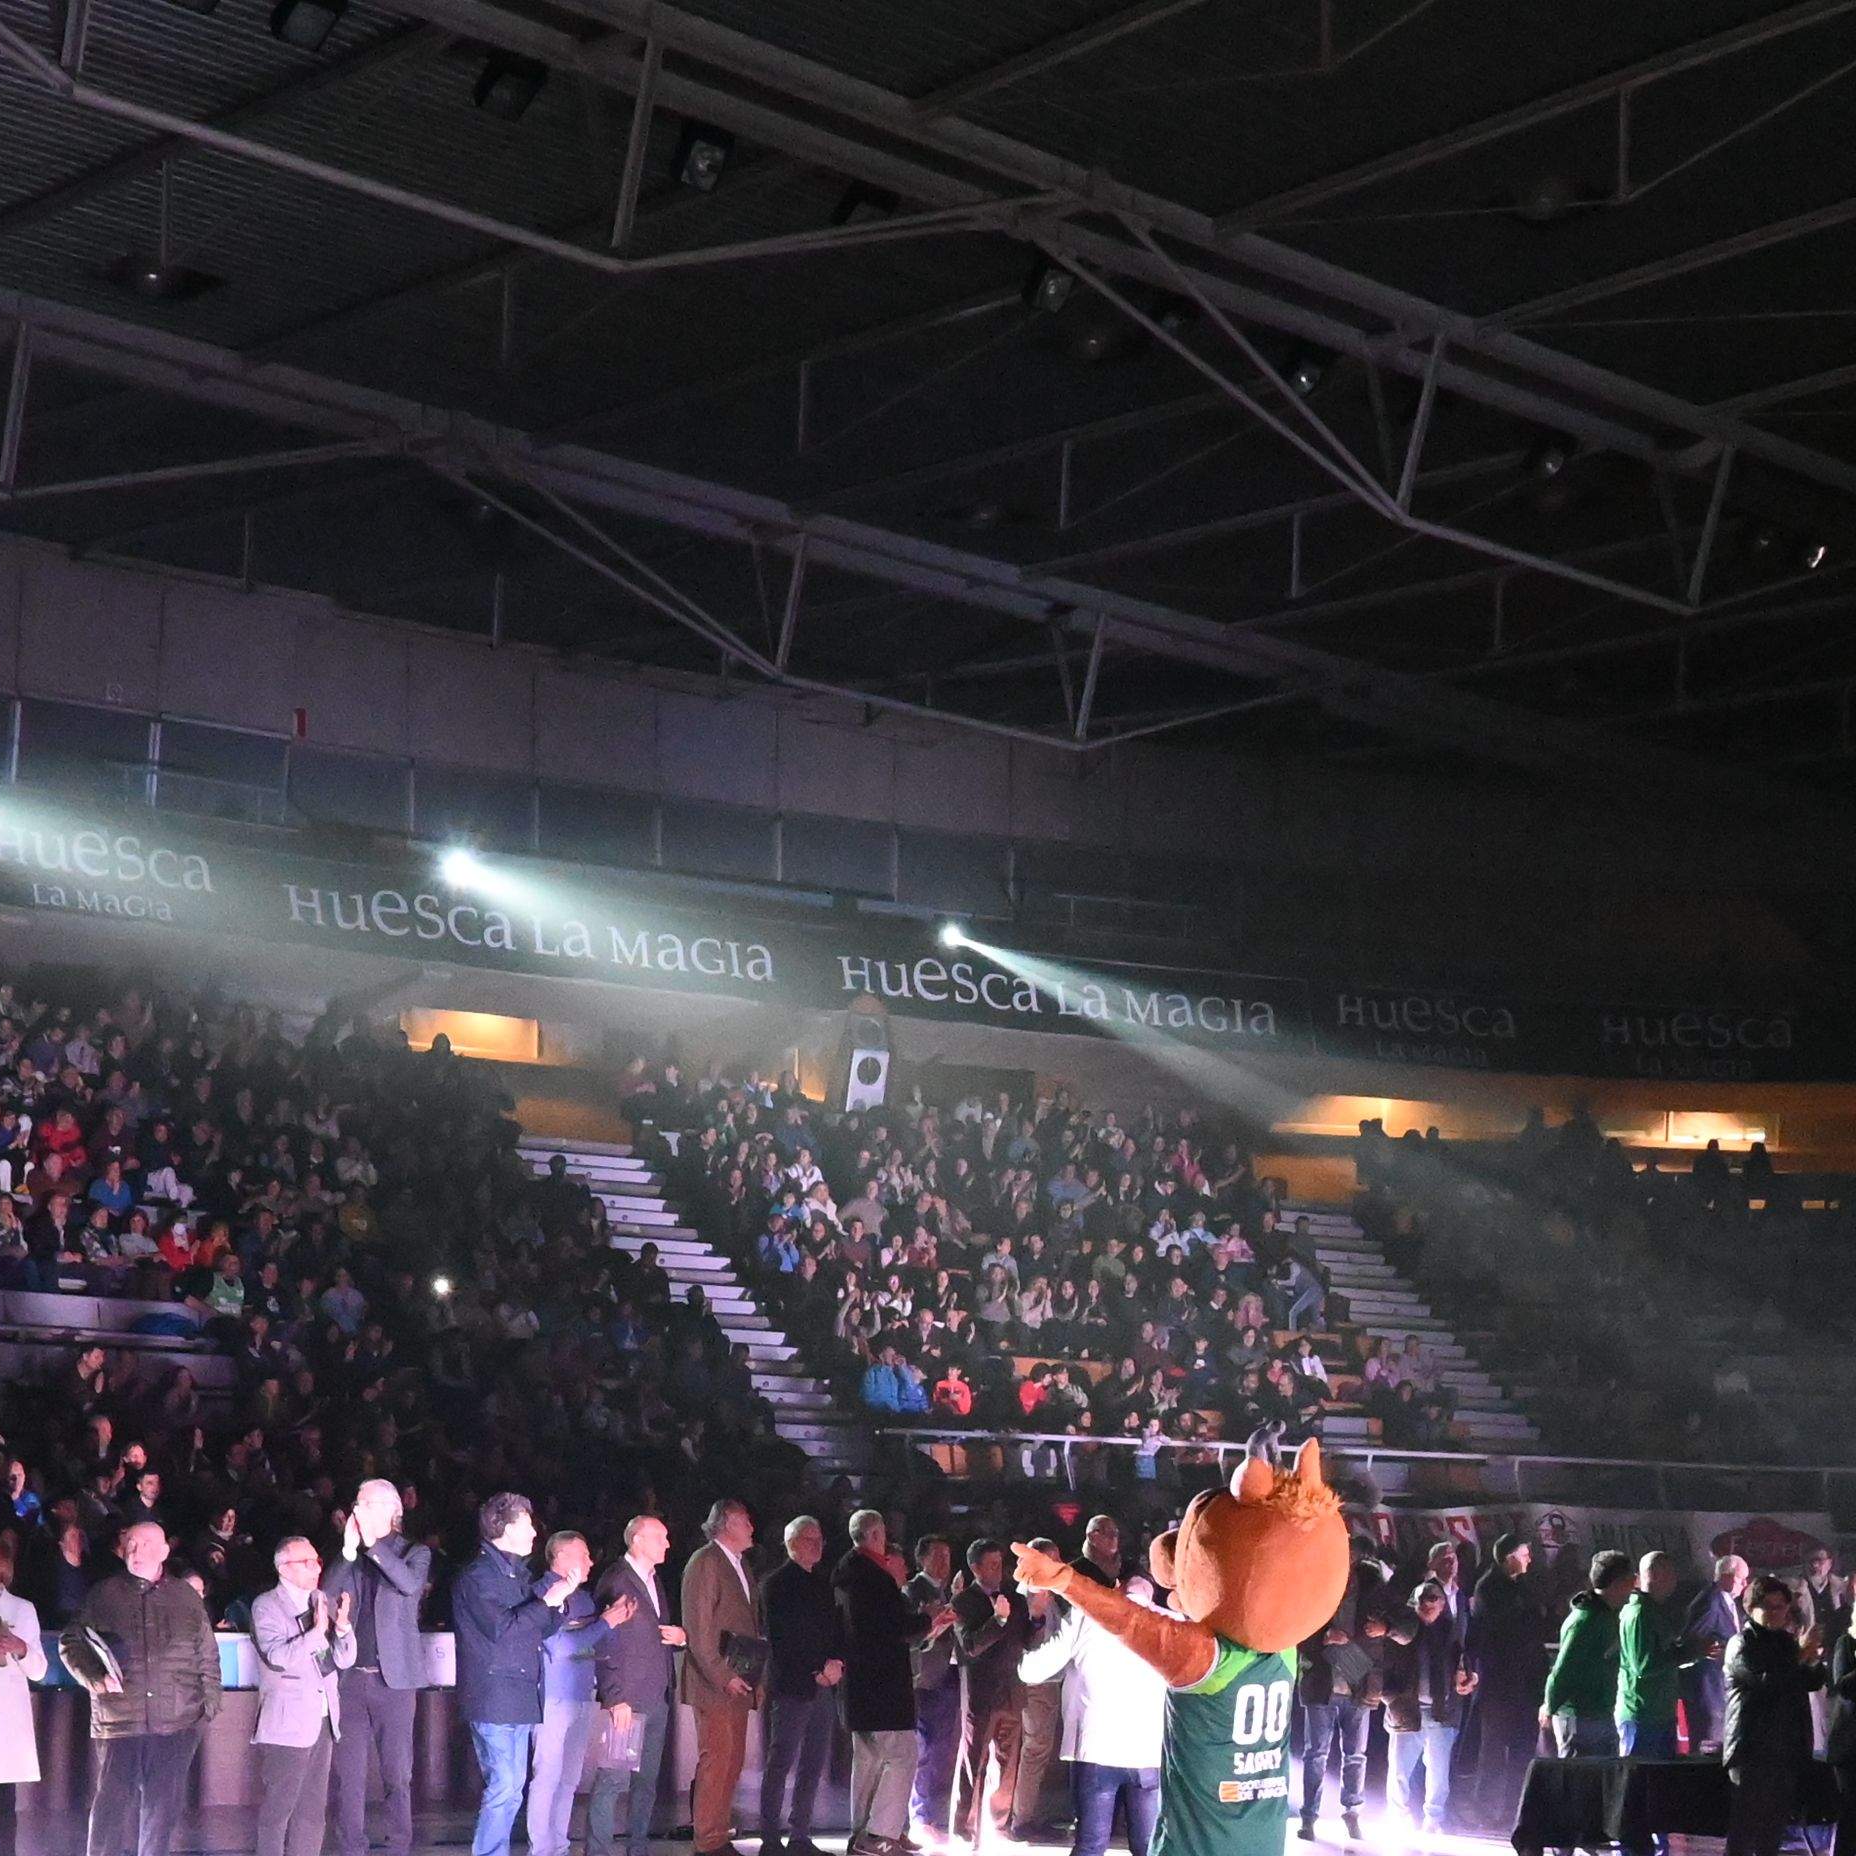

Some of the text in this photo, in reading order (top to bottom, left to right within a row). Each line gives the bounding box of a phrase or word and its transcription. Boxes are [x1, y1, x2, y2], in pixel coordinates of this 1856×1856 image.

[33, 883, 69, 908] La
[288, 884, 515, 951] Huesca
[535, 921, 595, 959] La
[838, 955, 1041, 1012] Huesca
[1058, 977, 1109, 1021] La
[1232, 1680, 1289, 1745] 00
